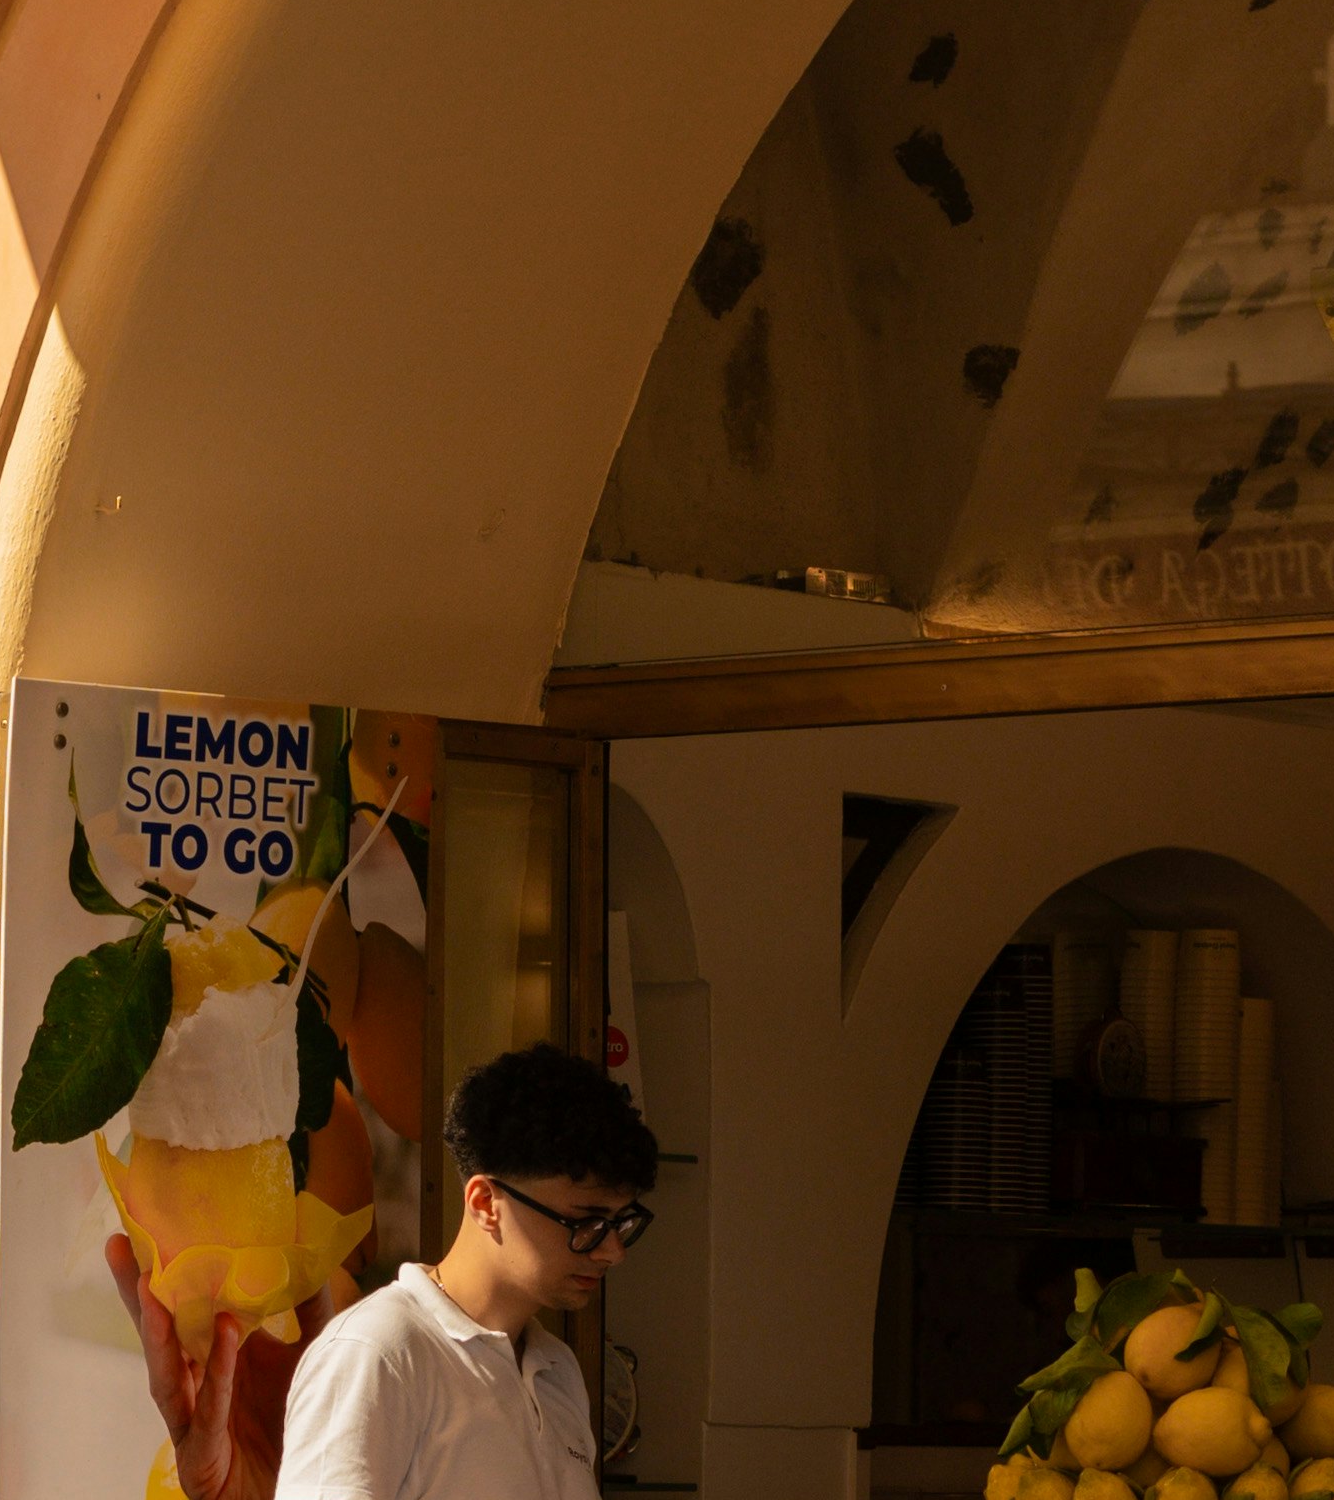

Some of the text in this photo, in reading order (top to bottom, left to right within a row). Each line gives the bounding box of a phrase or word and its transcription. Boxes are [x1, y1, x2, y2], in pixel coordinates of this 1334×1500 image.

[135, 711, 311, 771] LEMON
[125, 766, 316, 825] SORBET
[141, 821, 294, 877] TO GO
